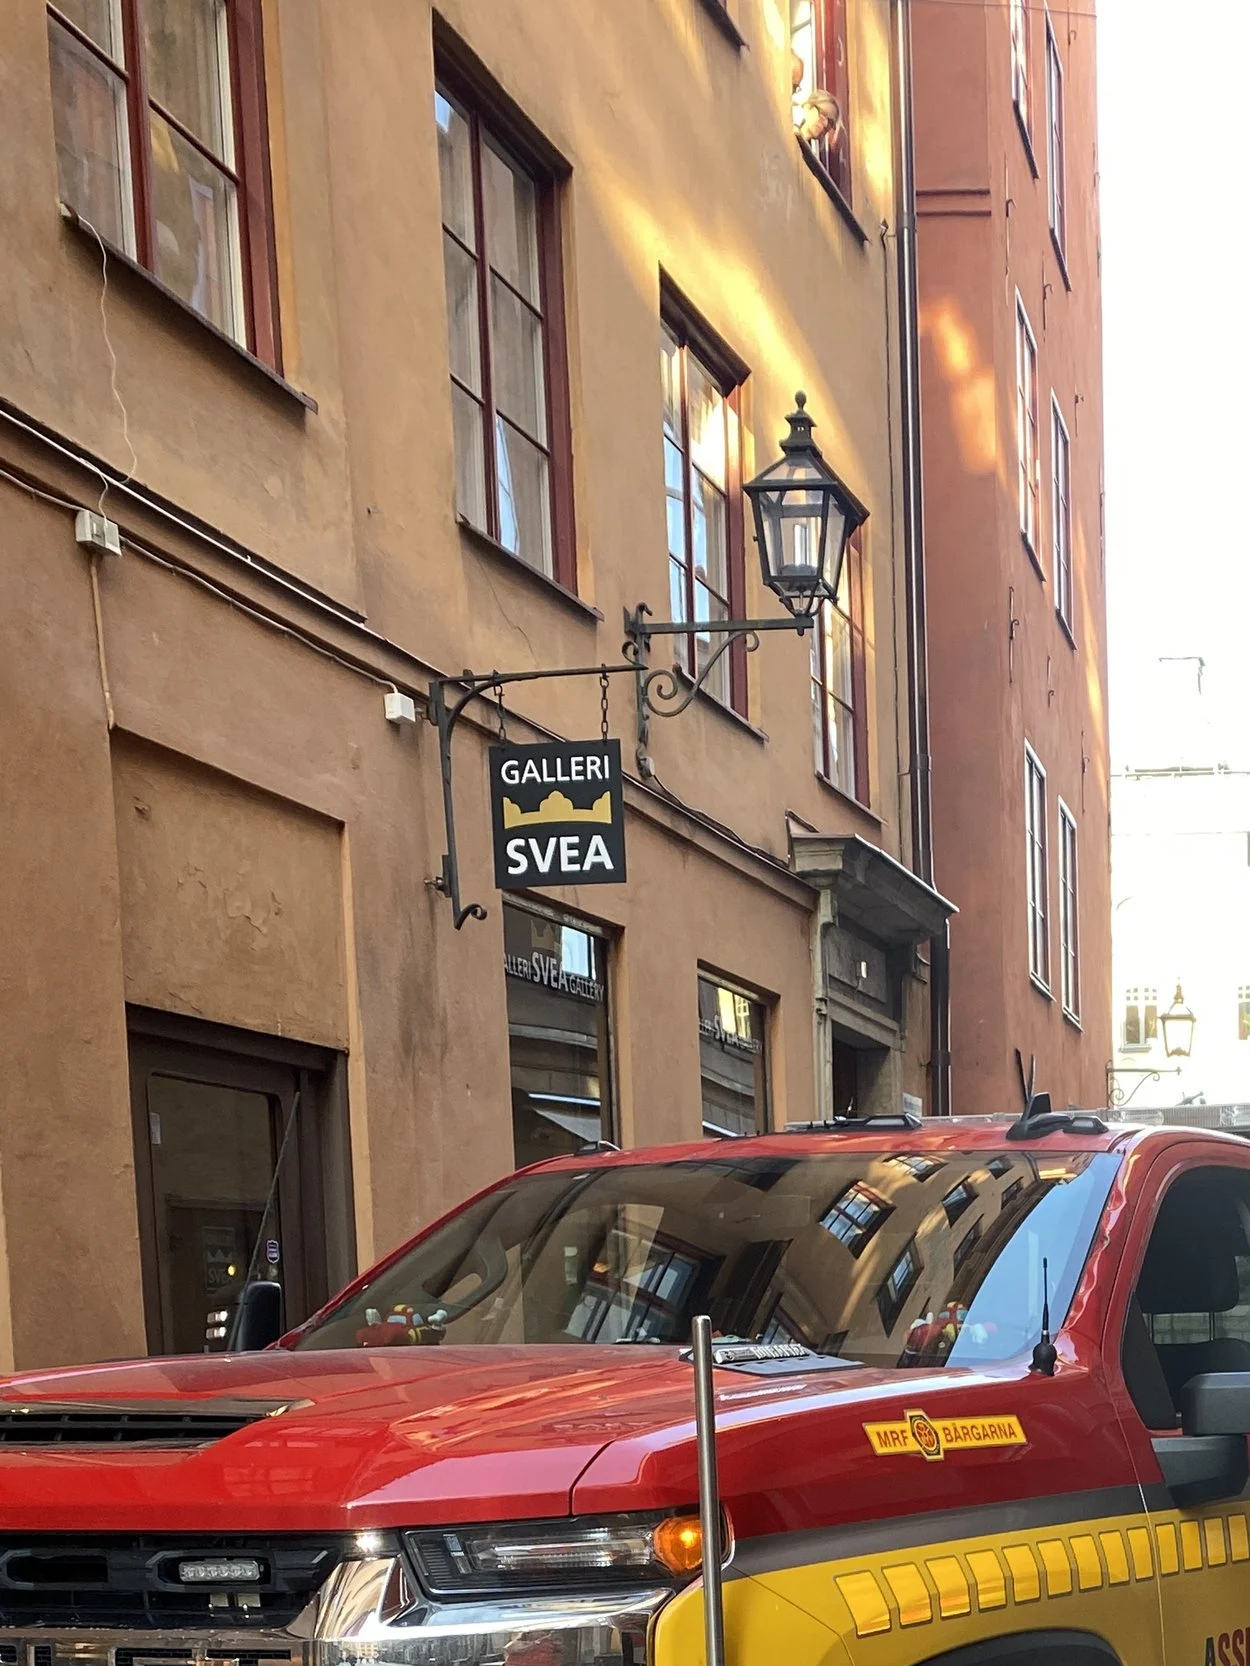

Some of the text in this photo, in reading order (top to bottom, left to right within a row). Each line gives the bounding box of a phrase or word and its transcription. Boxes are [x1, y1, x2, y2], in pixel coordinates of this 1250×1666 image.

[501, 755, 610, 784] GALLERI
[506, 834, 615, 875] SVEA
[532, 951, 569, 992] SVEA
[569, 974, 605, 1002] GALLERY
[875, 1430, 909, 1448] MRF
